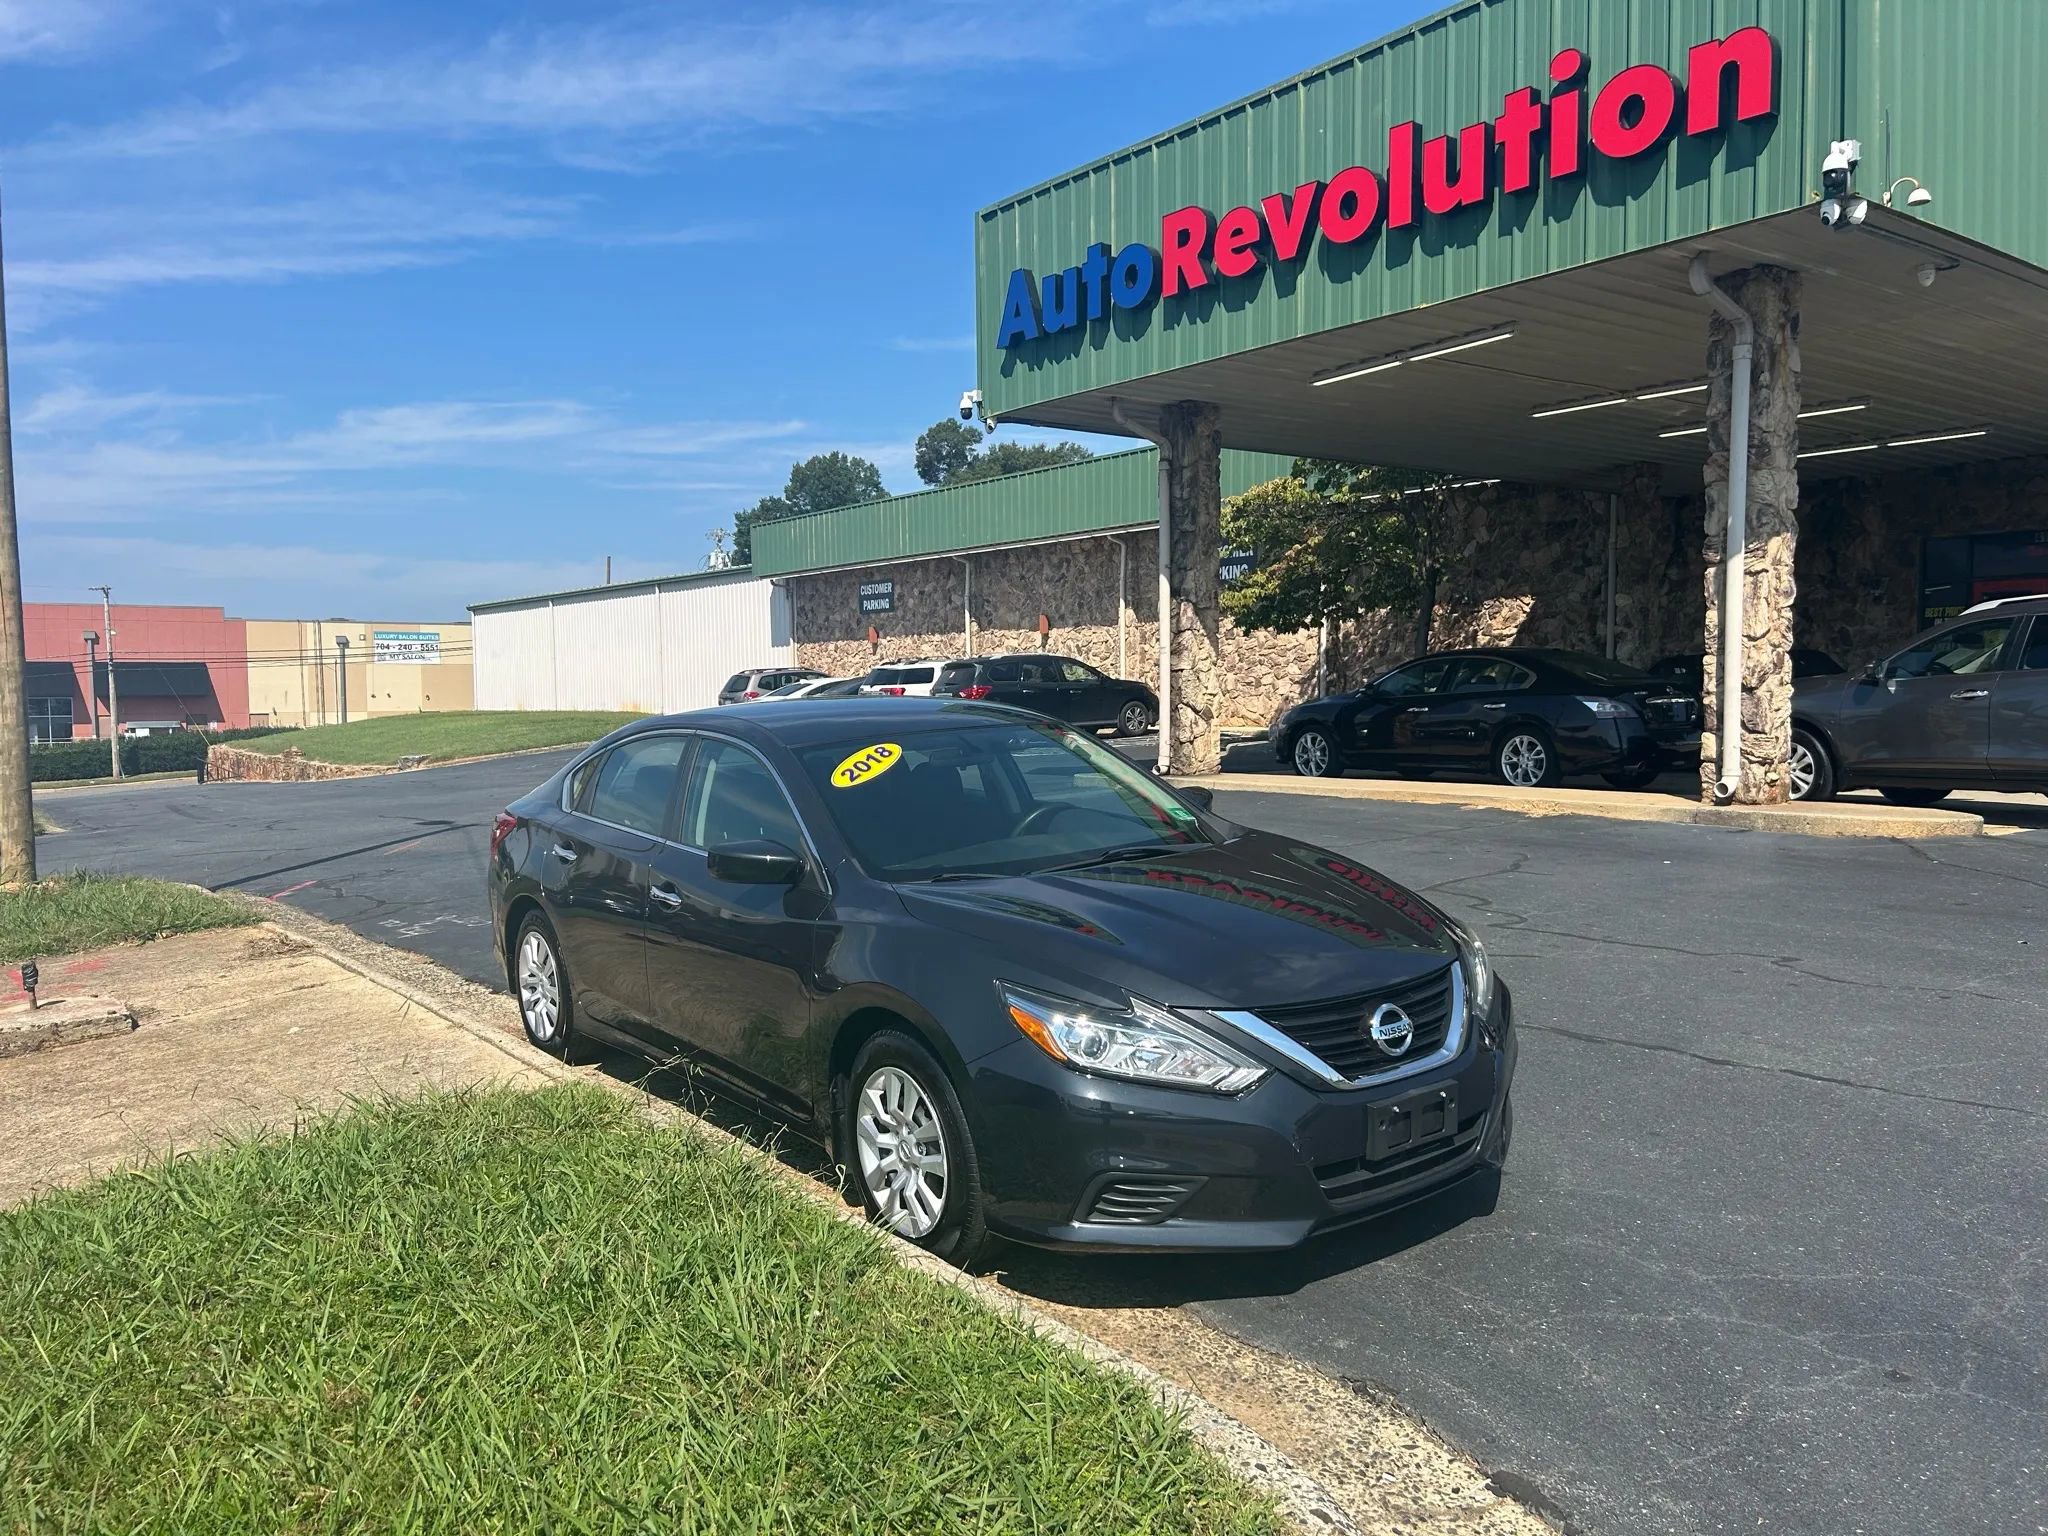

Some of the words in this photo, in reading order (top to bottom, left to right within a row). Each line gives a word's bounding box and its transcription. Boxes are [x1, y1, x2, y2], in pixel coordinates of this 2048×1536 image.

[860, 582, 892, 595] CUSTOMER
[863, 598, 890, 610] PARKING
[420, 643, 439, 651] 5551
[840, 746, 893, 783] 2018
[1379, 1023, 1412, 1037] NISSAN
